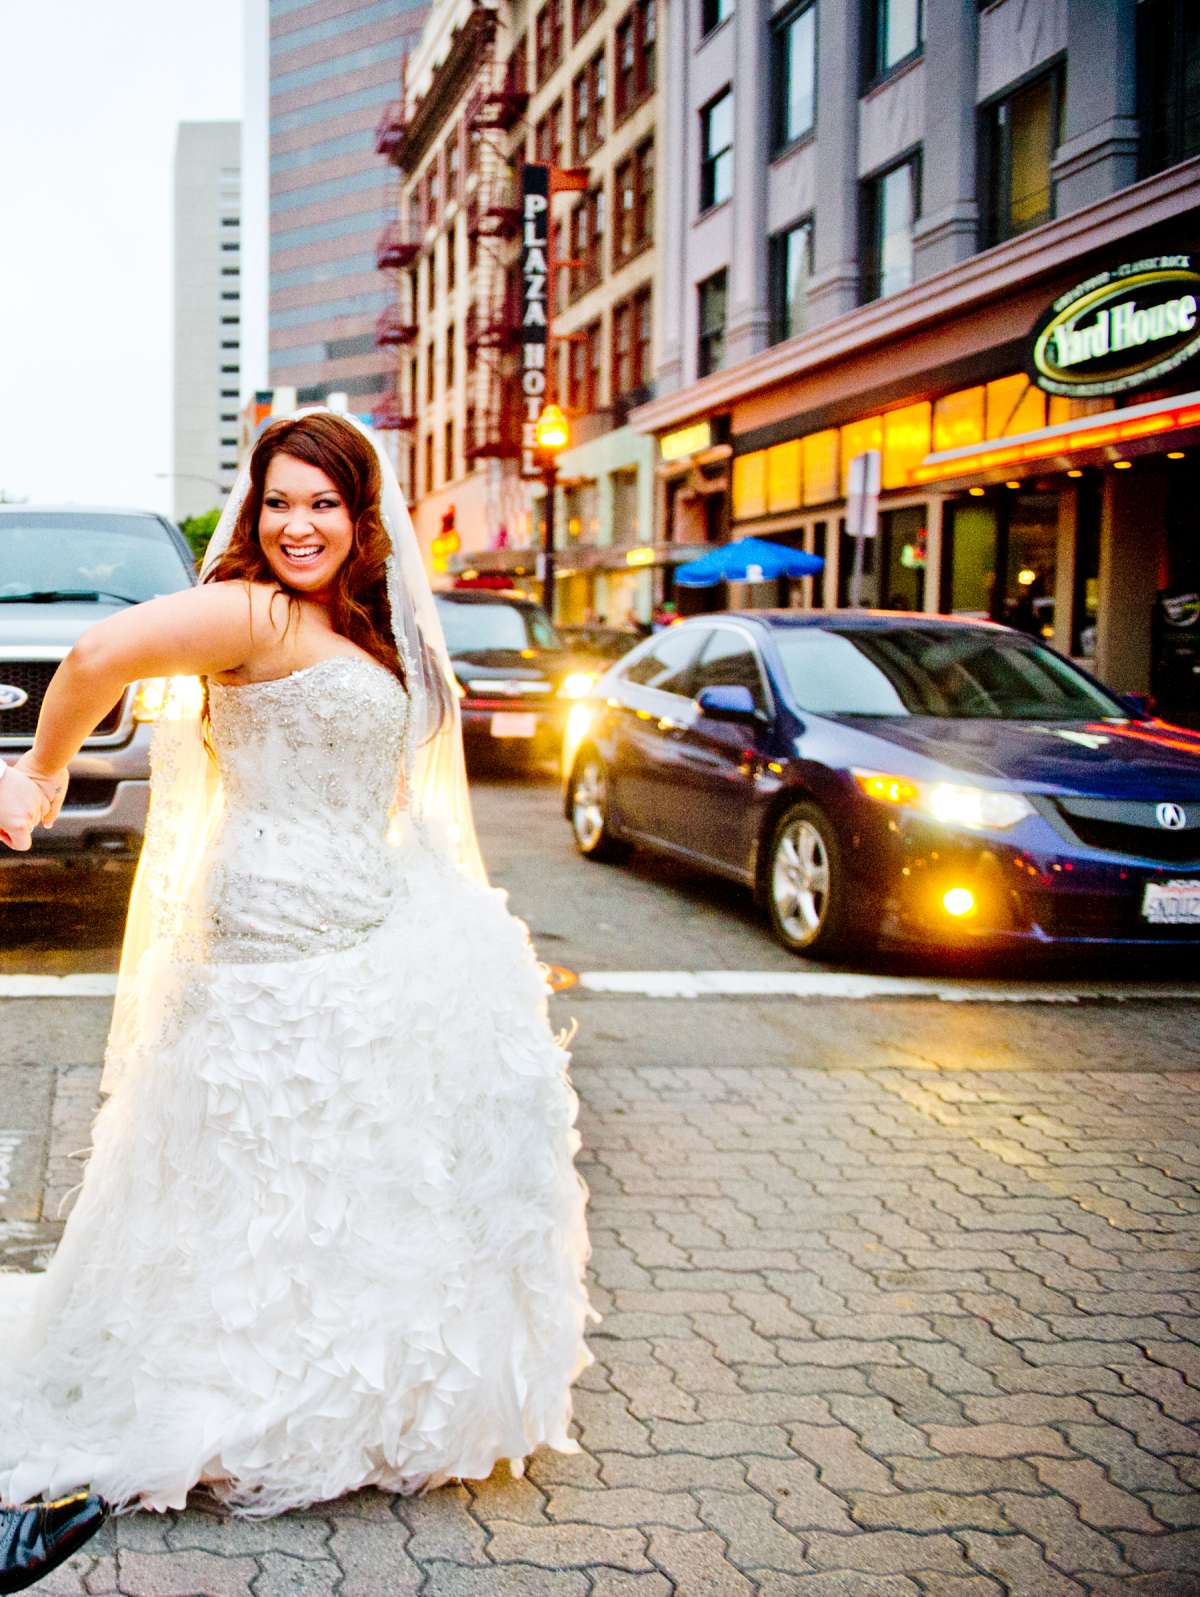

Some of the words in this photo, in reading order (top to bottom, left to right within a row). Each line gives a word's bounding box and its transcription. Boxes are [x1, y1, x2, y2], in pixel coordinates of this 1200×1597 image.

[523, 194, 547, 326] PLAZA
[1054, 310, 1110, 368] Yard
[1110, 294, 1197, 352] House
[522, 342, 546, 477] HOTEL
